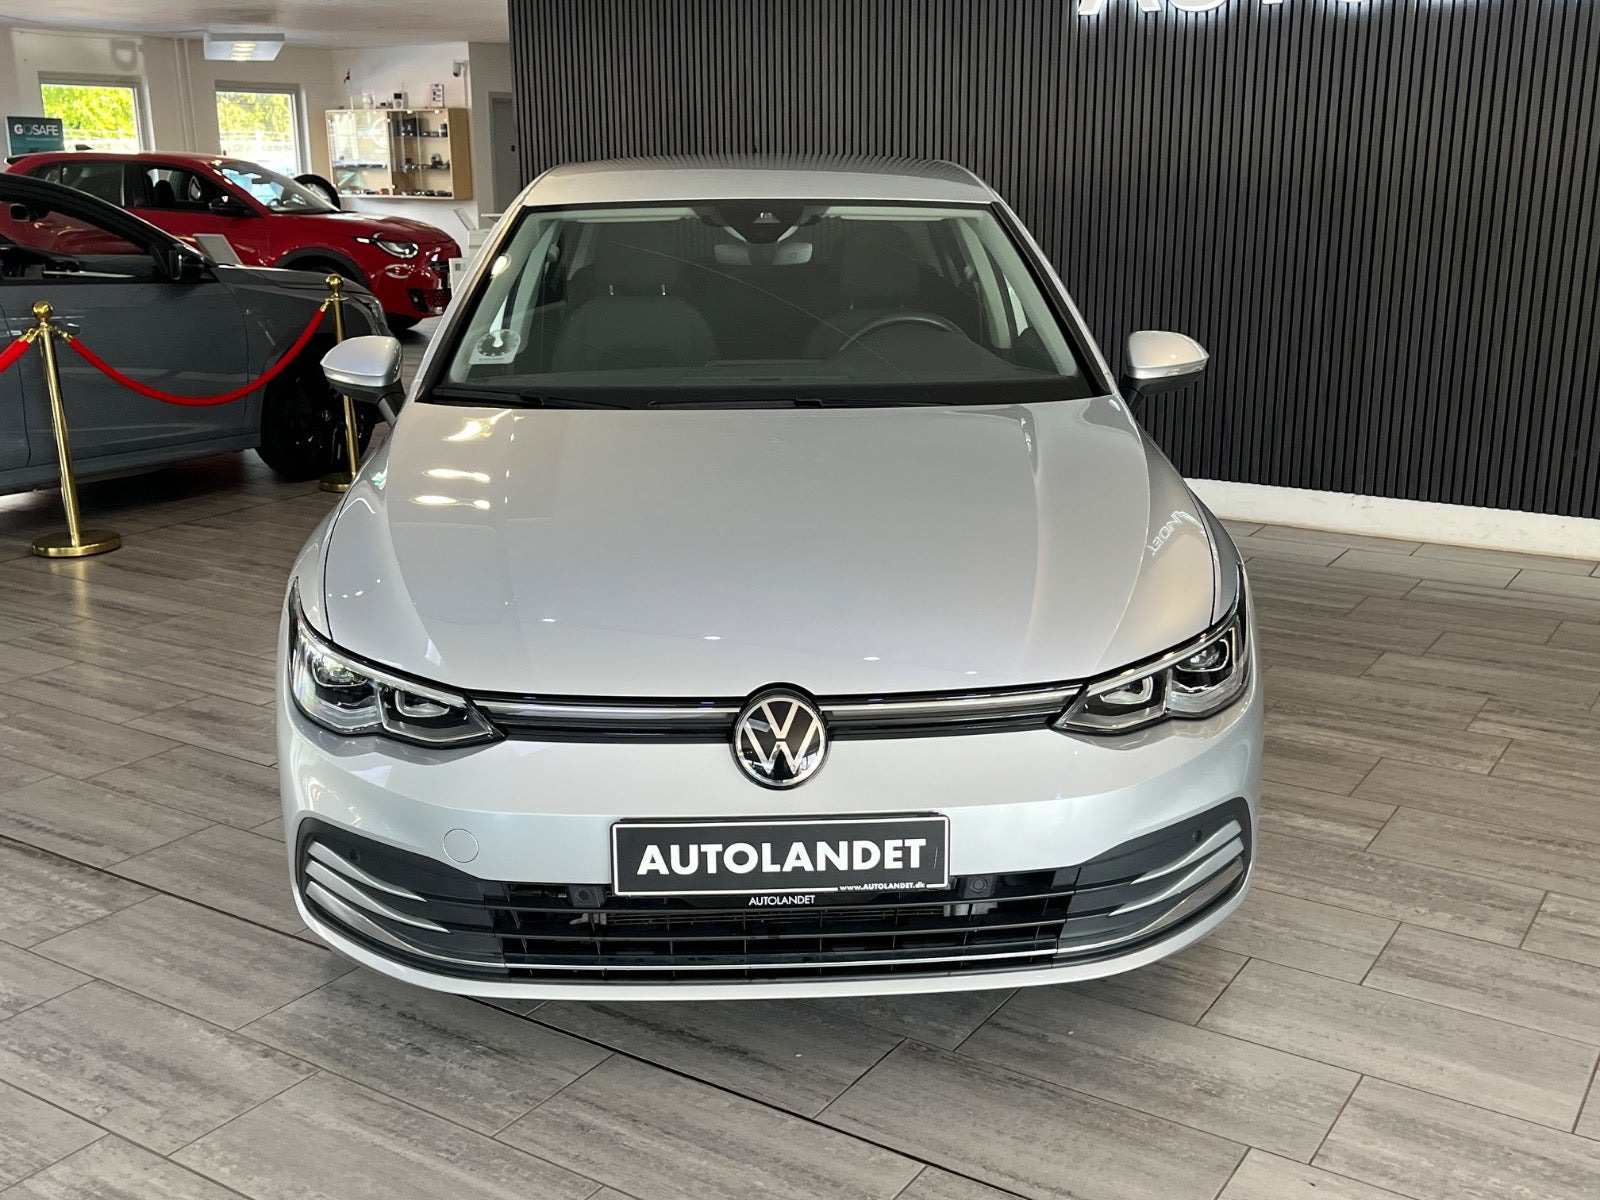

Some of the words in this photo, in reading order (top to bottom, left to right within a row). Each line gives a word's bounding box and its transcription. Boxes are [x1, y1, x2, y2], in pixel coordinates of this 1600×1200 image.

[14, 123, 60, 136] GOSAFE
[636, 838, 927, 875] AUTOLANDET
[839, 882, 926, 891] www.AUTOLANDET.dk
[748, 894, 816, 906] AUTOLANDET
